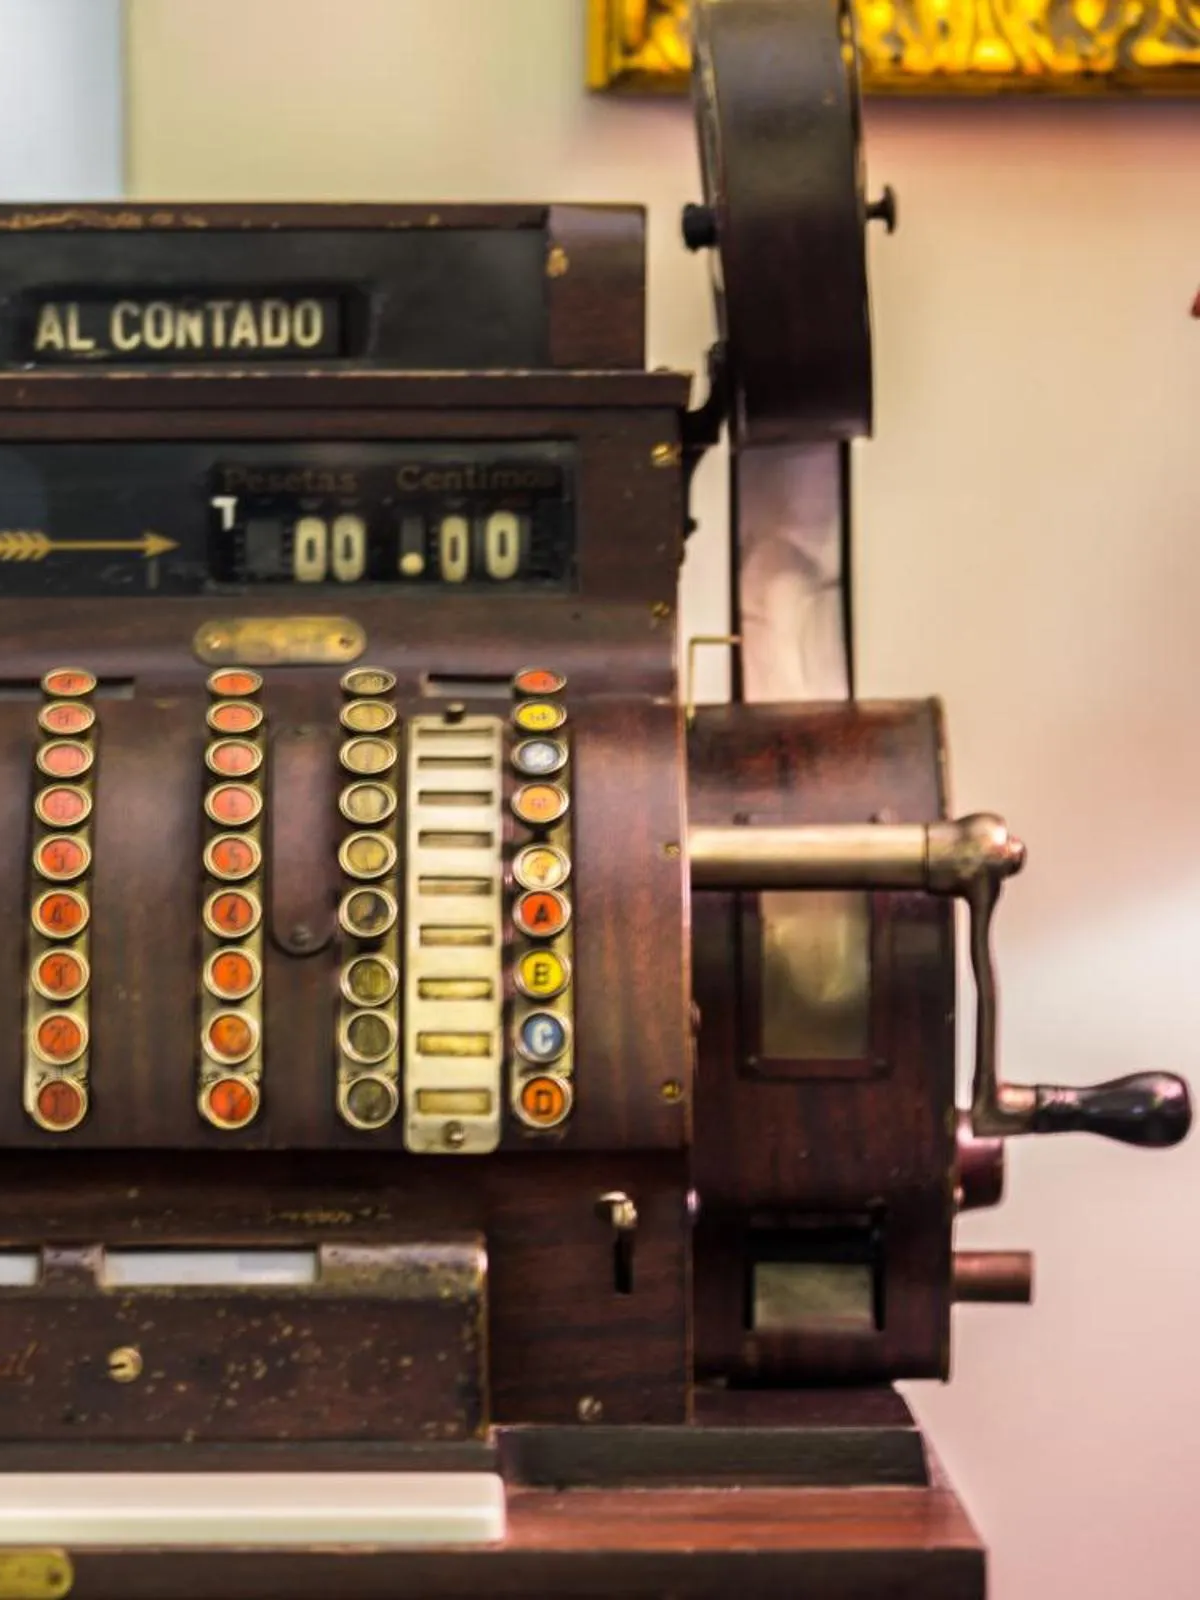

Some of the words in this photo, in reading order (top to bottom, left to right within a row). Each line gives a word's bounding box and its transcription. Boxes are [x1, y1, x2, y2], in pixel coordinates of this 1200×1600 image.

[35, 302, 95, 350] AL
[110, 300, 324, 350] CONTADO
[223, 467, 358, 492] Pesetas
[533, 903, 549, 925] A
[533, 962, 550, 986] B
[531, 1022, 554, 1054] C
